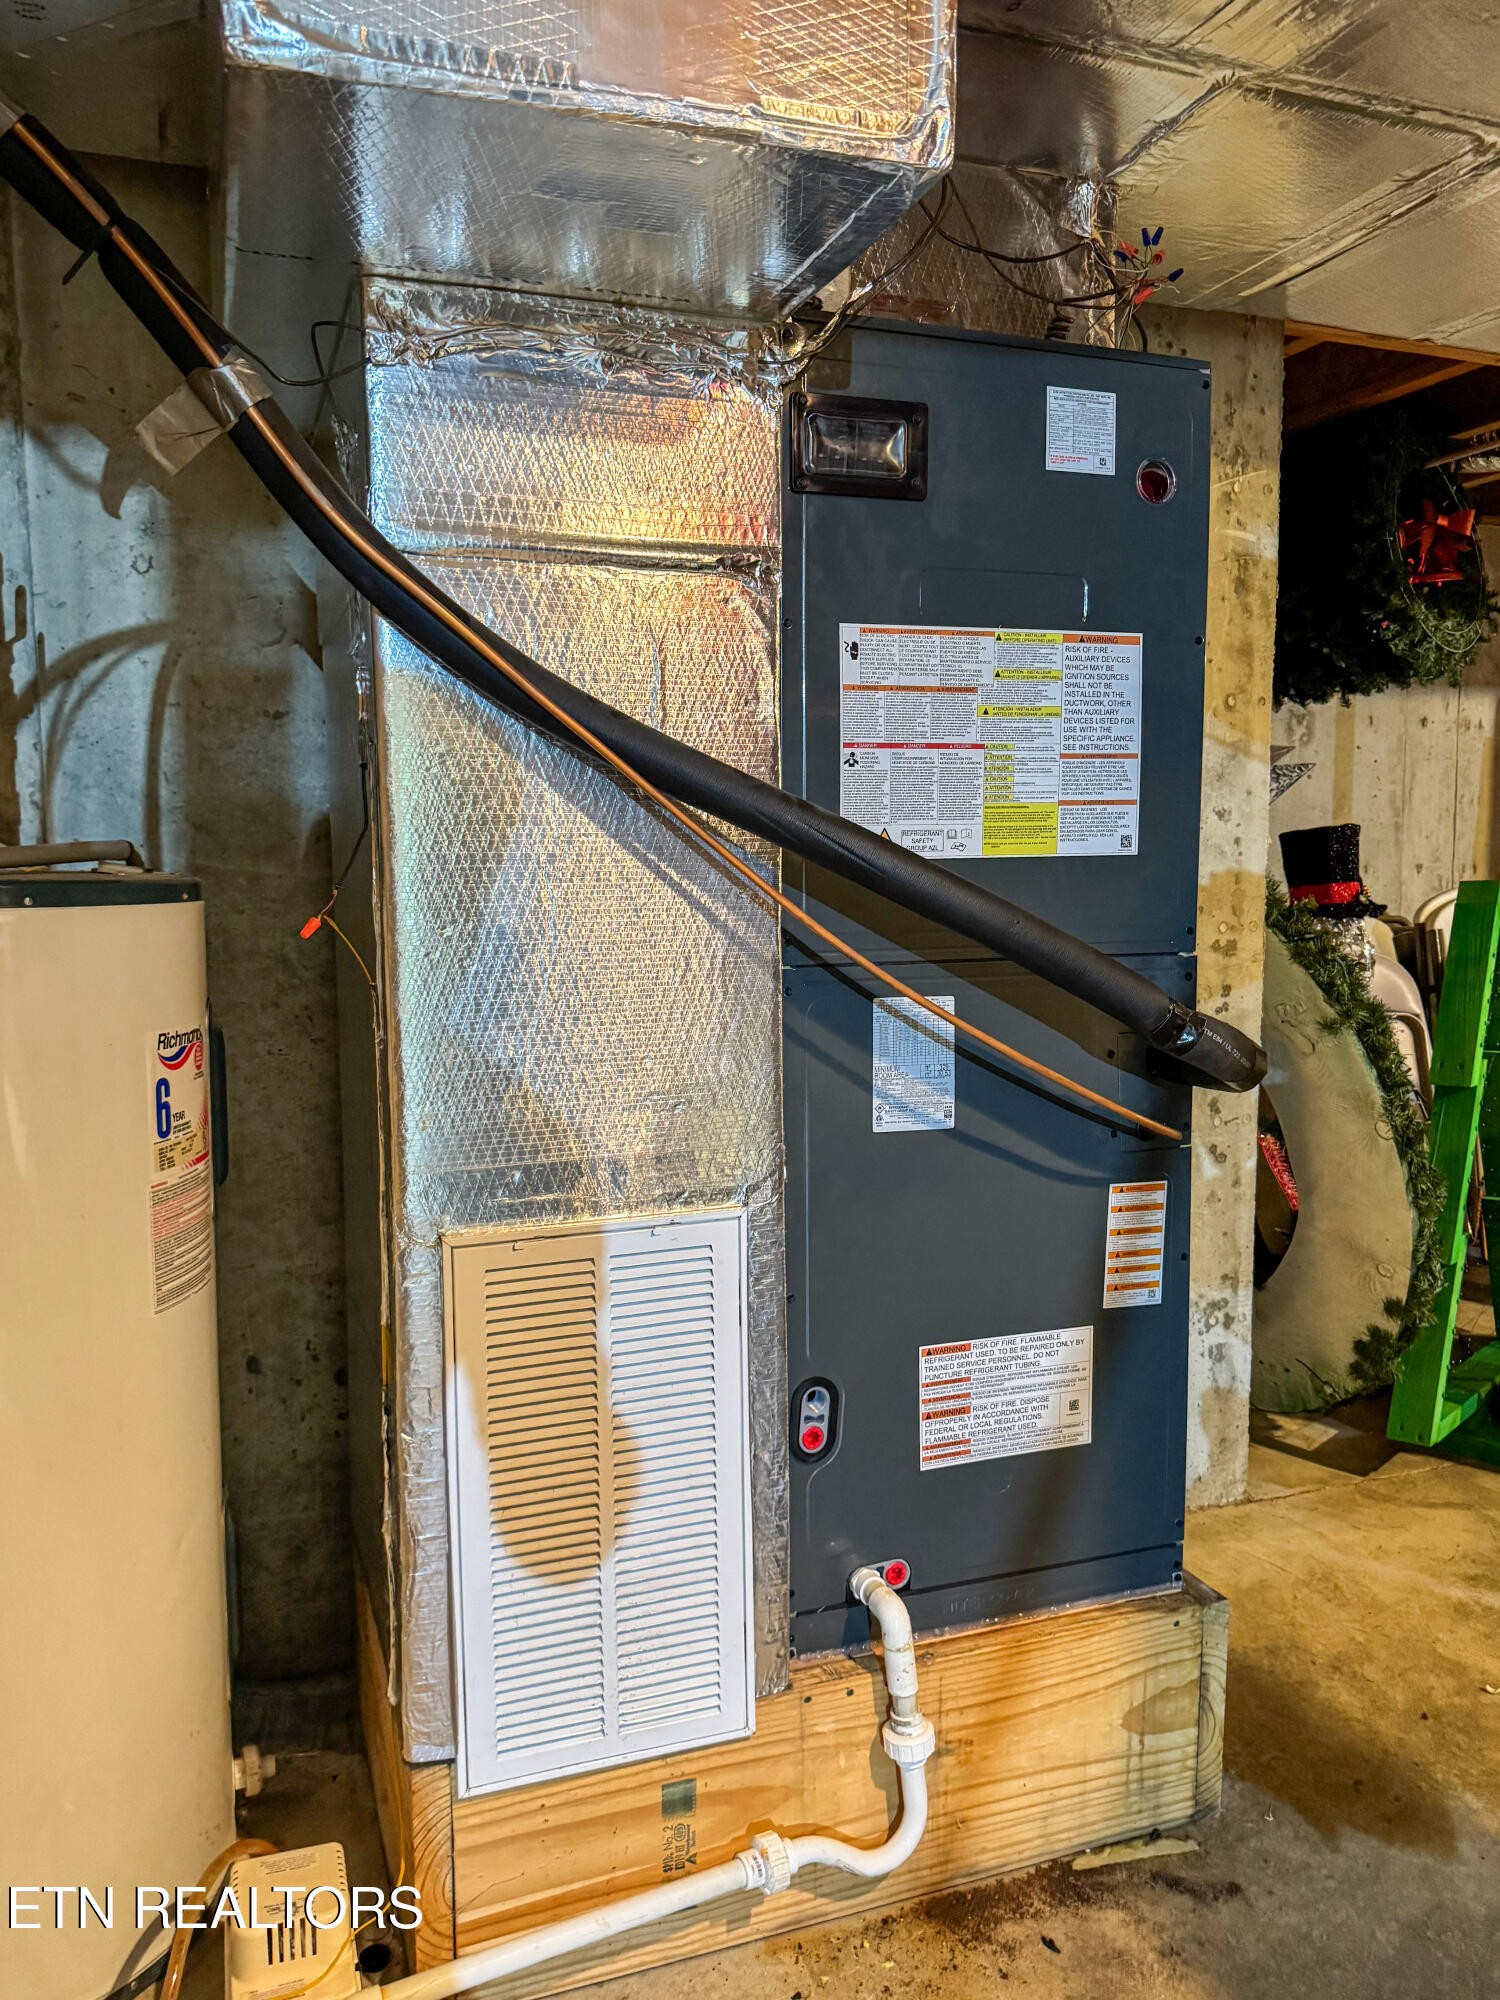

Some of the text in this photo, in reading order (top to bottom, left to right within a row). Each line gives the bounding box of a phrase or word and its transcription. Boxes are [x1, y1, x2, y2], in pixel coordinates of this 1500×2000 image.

[157, 1027, 203, 1050] Richmond
[156, 1078, 171, 1139] 6
[173, 1110, 185, 1122] YEAR
[924, 1352, 974, 1365] REFRIGERANT
[1020, 1342, 1054, 1352] REPAIRED
[932, 1345, 966, 1355] WARNING
[1021, 1334, 1061, 1344] FLAMMABLE
[924, 1363, 955, 1373] TRAINED
[956, 1359, 986, 1368] SERVICE
[924, 1370, 963, 1381] PUNCTURE
[964, 1364, 1013, 1376] REFRIGERANT
[924, 1415, 972, 1428] OFPROPERLY
[981, 1407, 1029, 1418] ACCORDANCE
[932, 1407, 966, 1419] WARNING
[1020, 1396, 1050, 1406] DISPOSE
[925, 1426, 956, 1436] FEDERAL
[970, 1420, 992, 1429] LOCAL
[925, 1432, 966, 1444] FLAMMABLE
[968, 1424, 1016, 1437] REFRIGERANT
